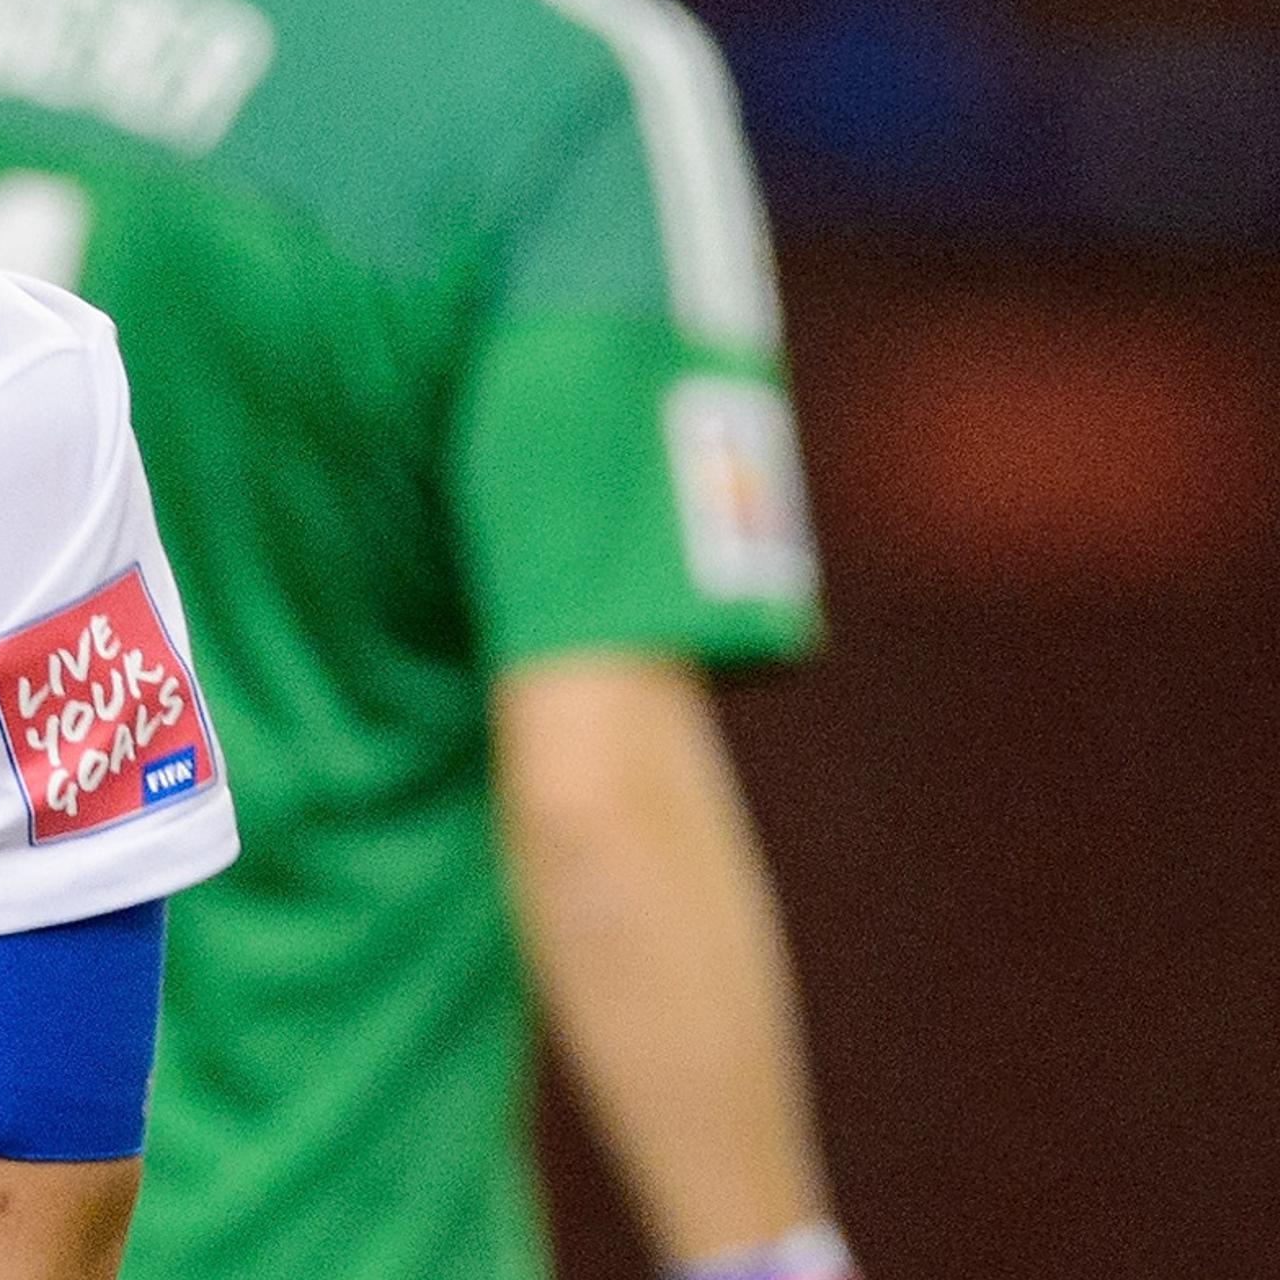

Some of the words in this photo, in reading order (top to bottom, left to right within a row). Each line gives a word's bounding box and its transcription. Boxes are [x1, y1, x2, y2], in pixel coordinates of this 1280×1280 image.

[17, 614, 121, 719] LIVE
[25, 648, 165, 768] YOUR
[46, 676, 184, 817] GOALS
[146, 760, 193, 792] FIFA
